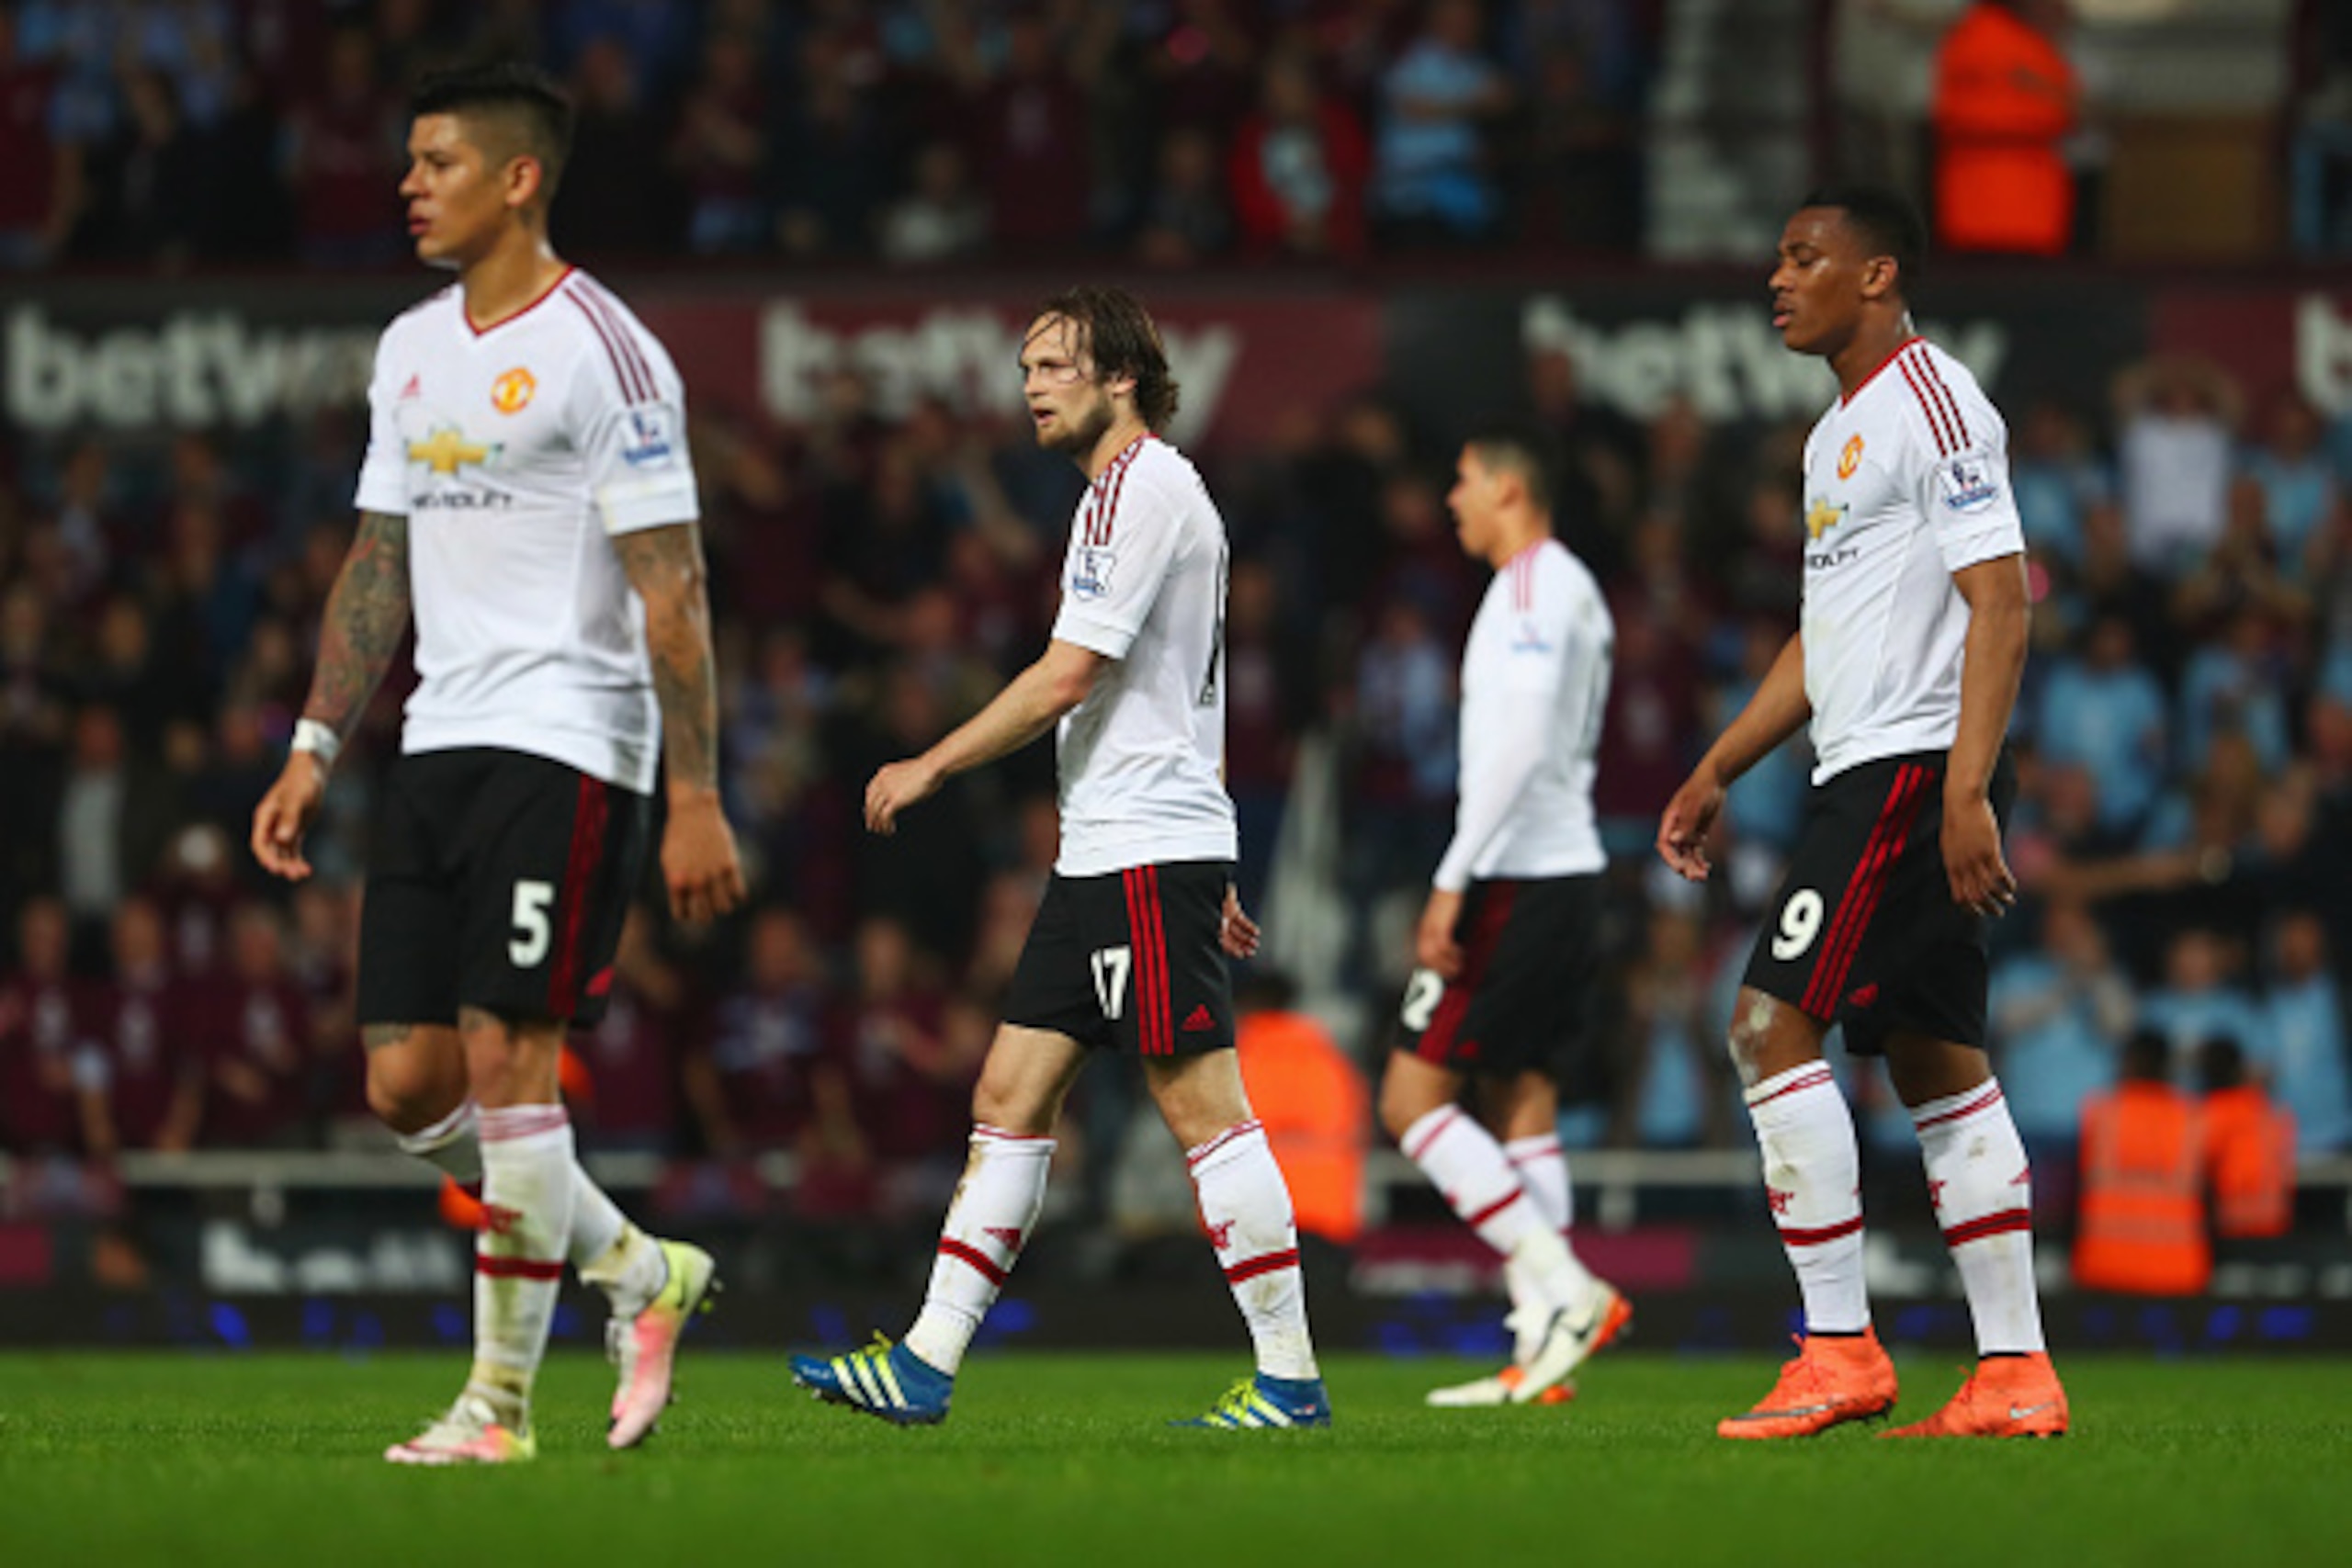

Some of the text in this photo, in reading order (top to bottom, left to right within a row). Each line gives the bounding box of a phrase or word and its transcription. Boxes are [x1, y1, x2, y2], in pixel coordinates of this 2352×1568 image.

[759, 299, 1242, 448] betwy
[1521, 299, 2007, 423] betwy
[508, 879, 553, 969] 5
[1772, 888, 1824, 961] 9
[1091, 945, 1130, 1020] 17
